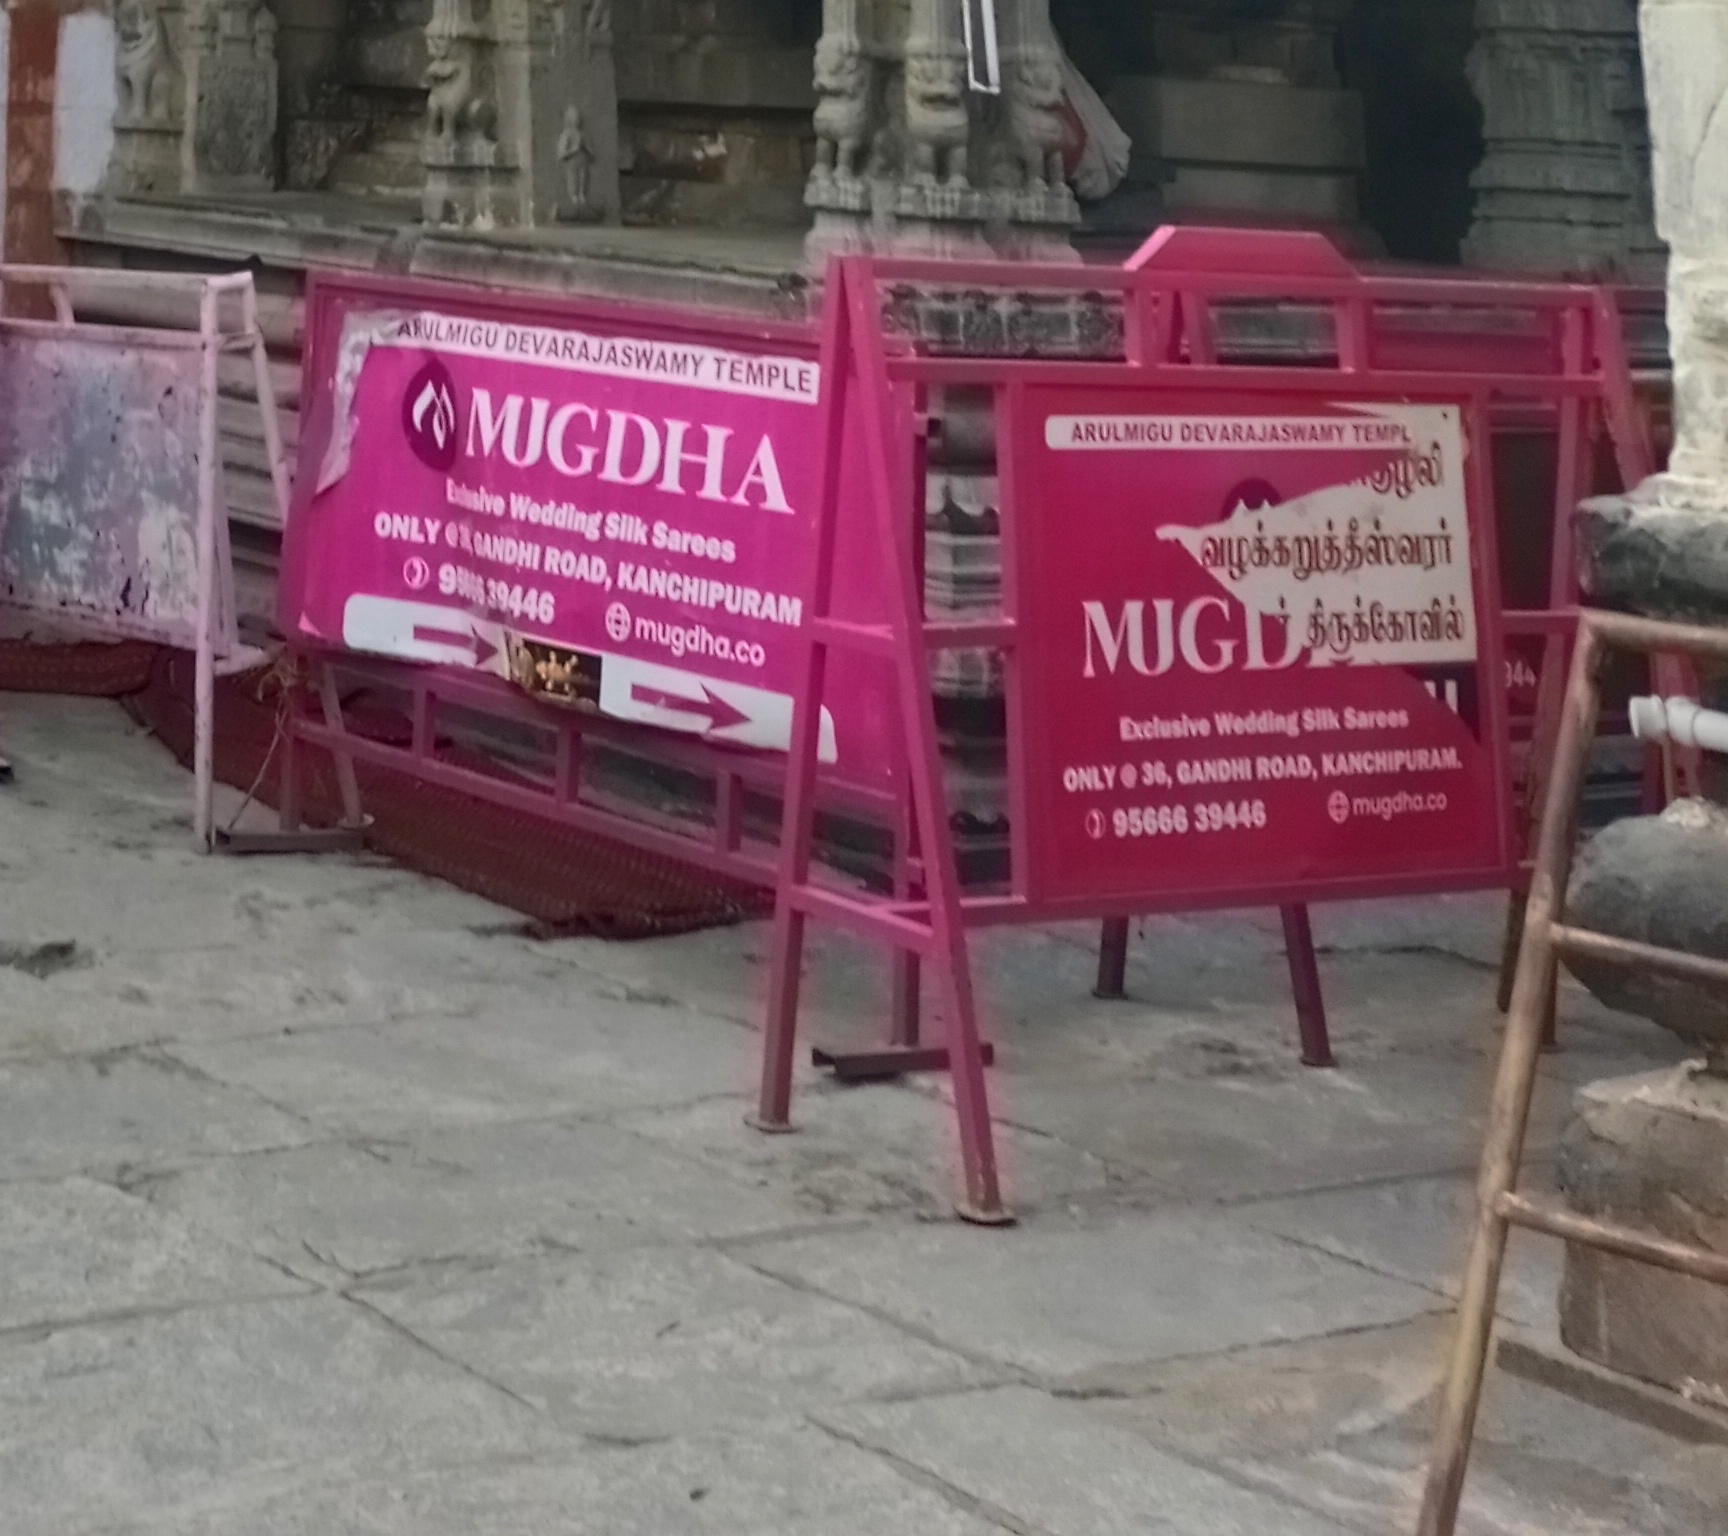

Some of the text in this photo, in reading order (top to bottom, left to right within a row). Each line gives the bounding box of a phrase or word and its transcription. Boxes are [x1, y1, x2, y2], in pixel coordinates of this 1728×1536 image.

[397, 317, 812, 394] ARULMIGU DEVARAJASWAMY TEMPLE
[465, 387, 796, 515] MUGDHA
[1072, 423, 1412, 443] ARULMIGU DEVARAJASWAMY TEMPL
[510, 492, 603, 541] Wedding
[604, 511, 649, 546] Silk
[652, 520, 737, 563] Sarees
[374, 511, 442, 545] ONLY
[474, 532, 541, 570] GANDHI
[544, 545, 612, 592] ROAD,
[618, 561, 803, 627] KANCHIPURAM
[486, 579, 556, 625] 39446
[635, 616, 766, 667] mugdha.co
[1081, 595, 1308, 679] MUGD
[1120, 706, 1409, 741] Exclusive Wedding Silk Sarees
[1063, 764, 1116, 792] ONLY
[1176, 756, 1252, 785] GANDHI
[1256, 754, 1318, 782] ROAD,
[1112, 799, 1267, 838] 95666 39446
[1352, 790, 1448, 821] mugdha.co
